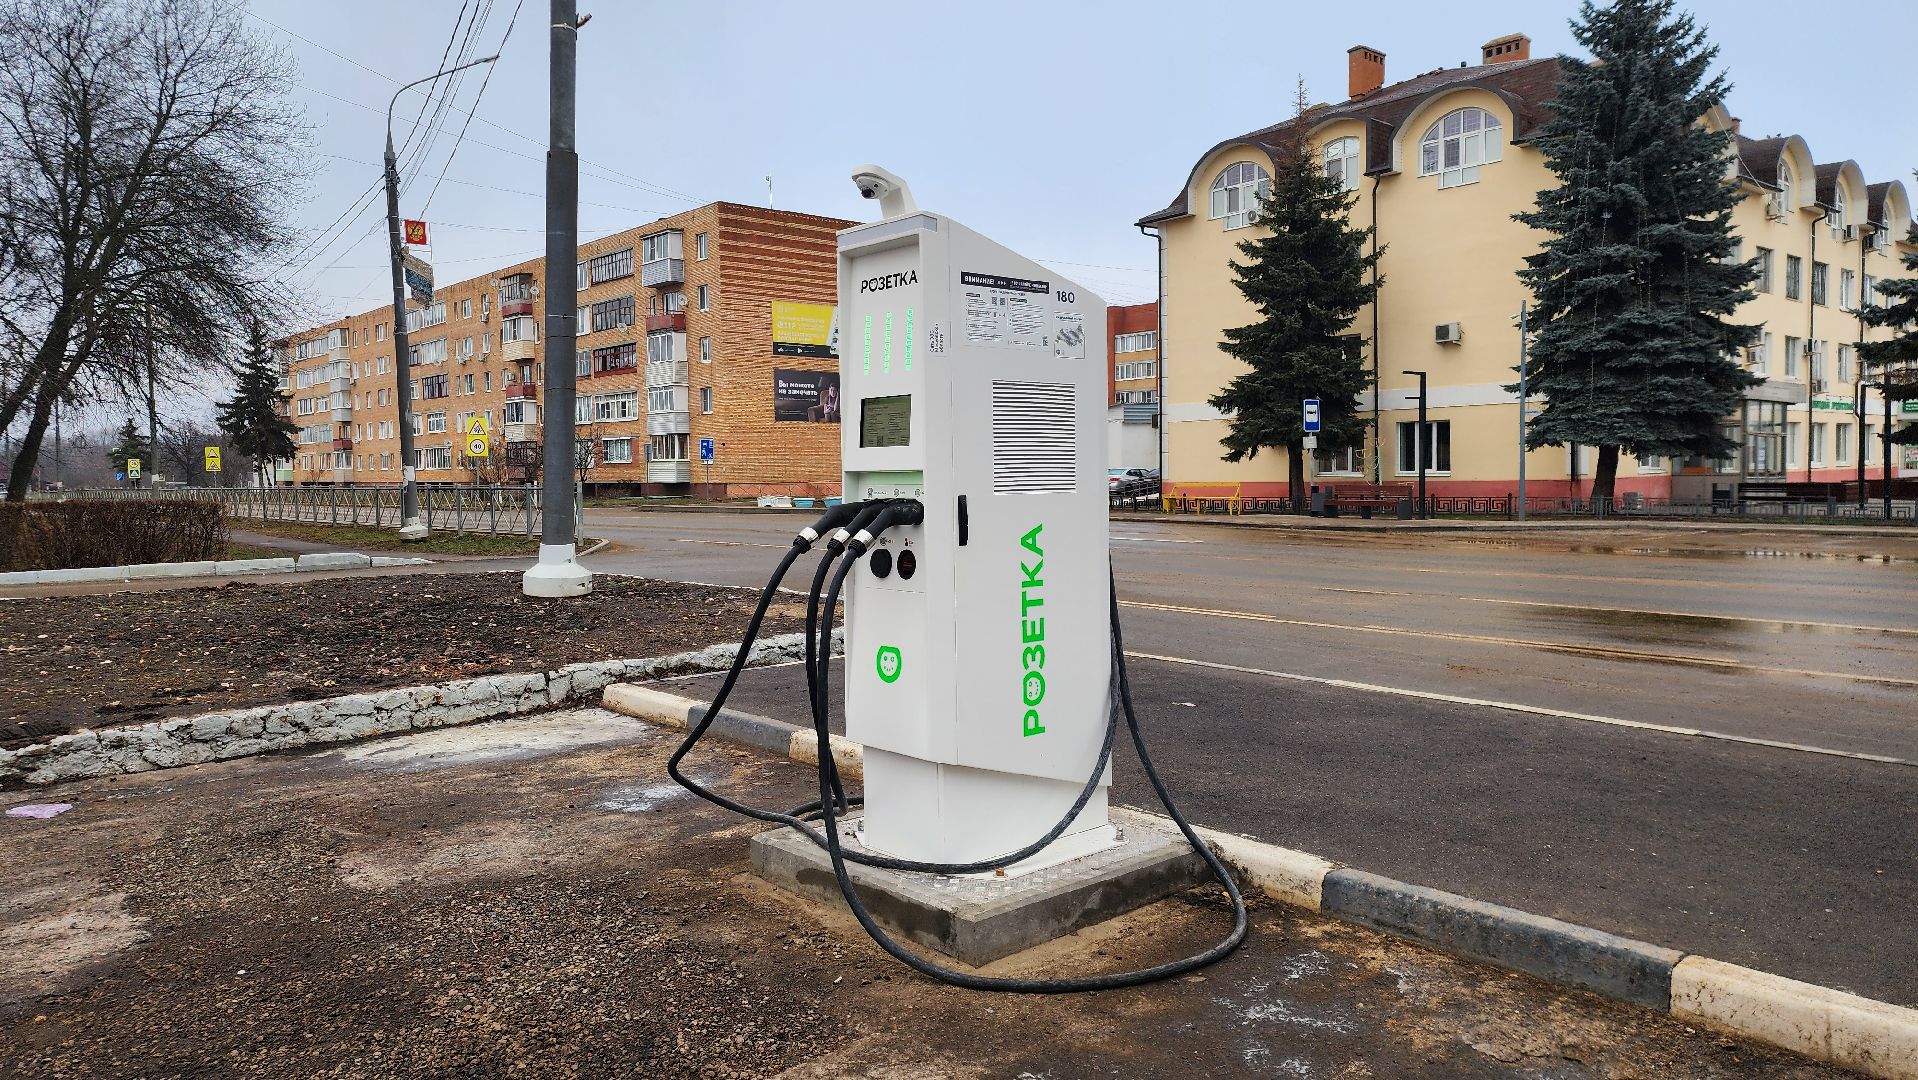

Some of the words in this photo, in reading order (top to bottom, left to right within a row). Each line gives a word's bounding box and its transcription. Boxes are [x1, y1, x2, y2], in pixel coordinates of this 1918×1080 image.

[861, 270, 918, 293] РОЗЕТКА
[1056, 291, 1075, 303] 180
[778, 380, 788, 388] Вы
[1020, 523, 1046, 737] РОЗЕТКА
